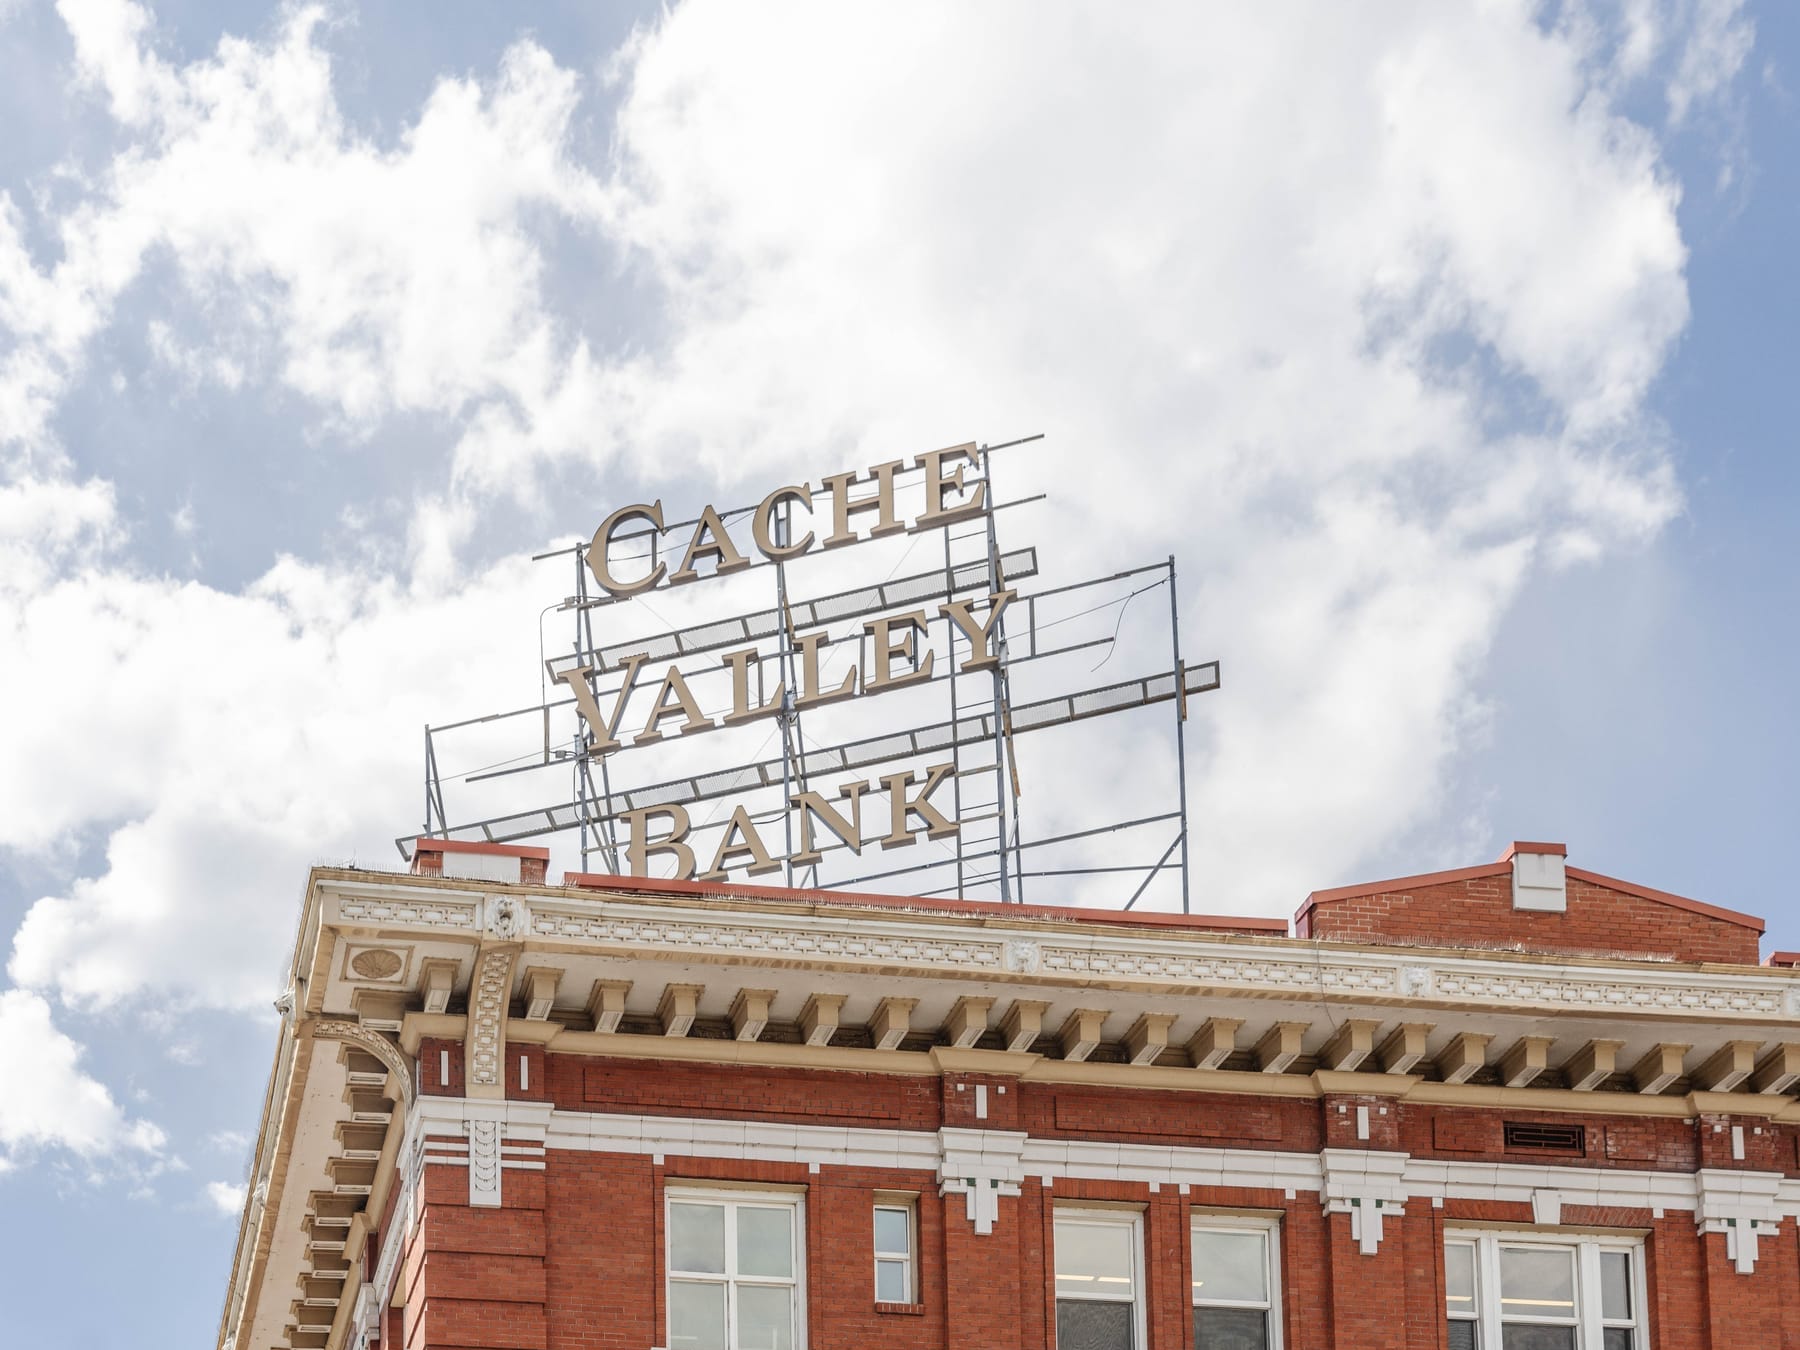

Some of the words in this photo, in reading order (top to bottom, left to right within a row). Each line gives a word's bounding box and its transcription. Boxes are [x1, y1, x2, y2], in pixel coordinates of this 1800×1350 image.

[584, 441, 986, 597] CACHE
[557, 589, 1017, 753] VALLEY
[619, 762, 959, 882] BANK
